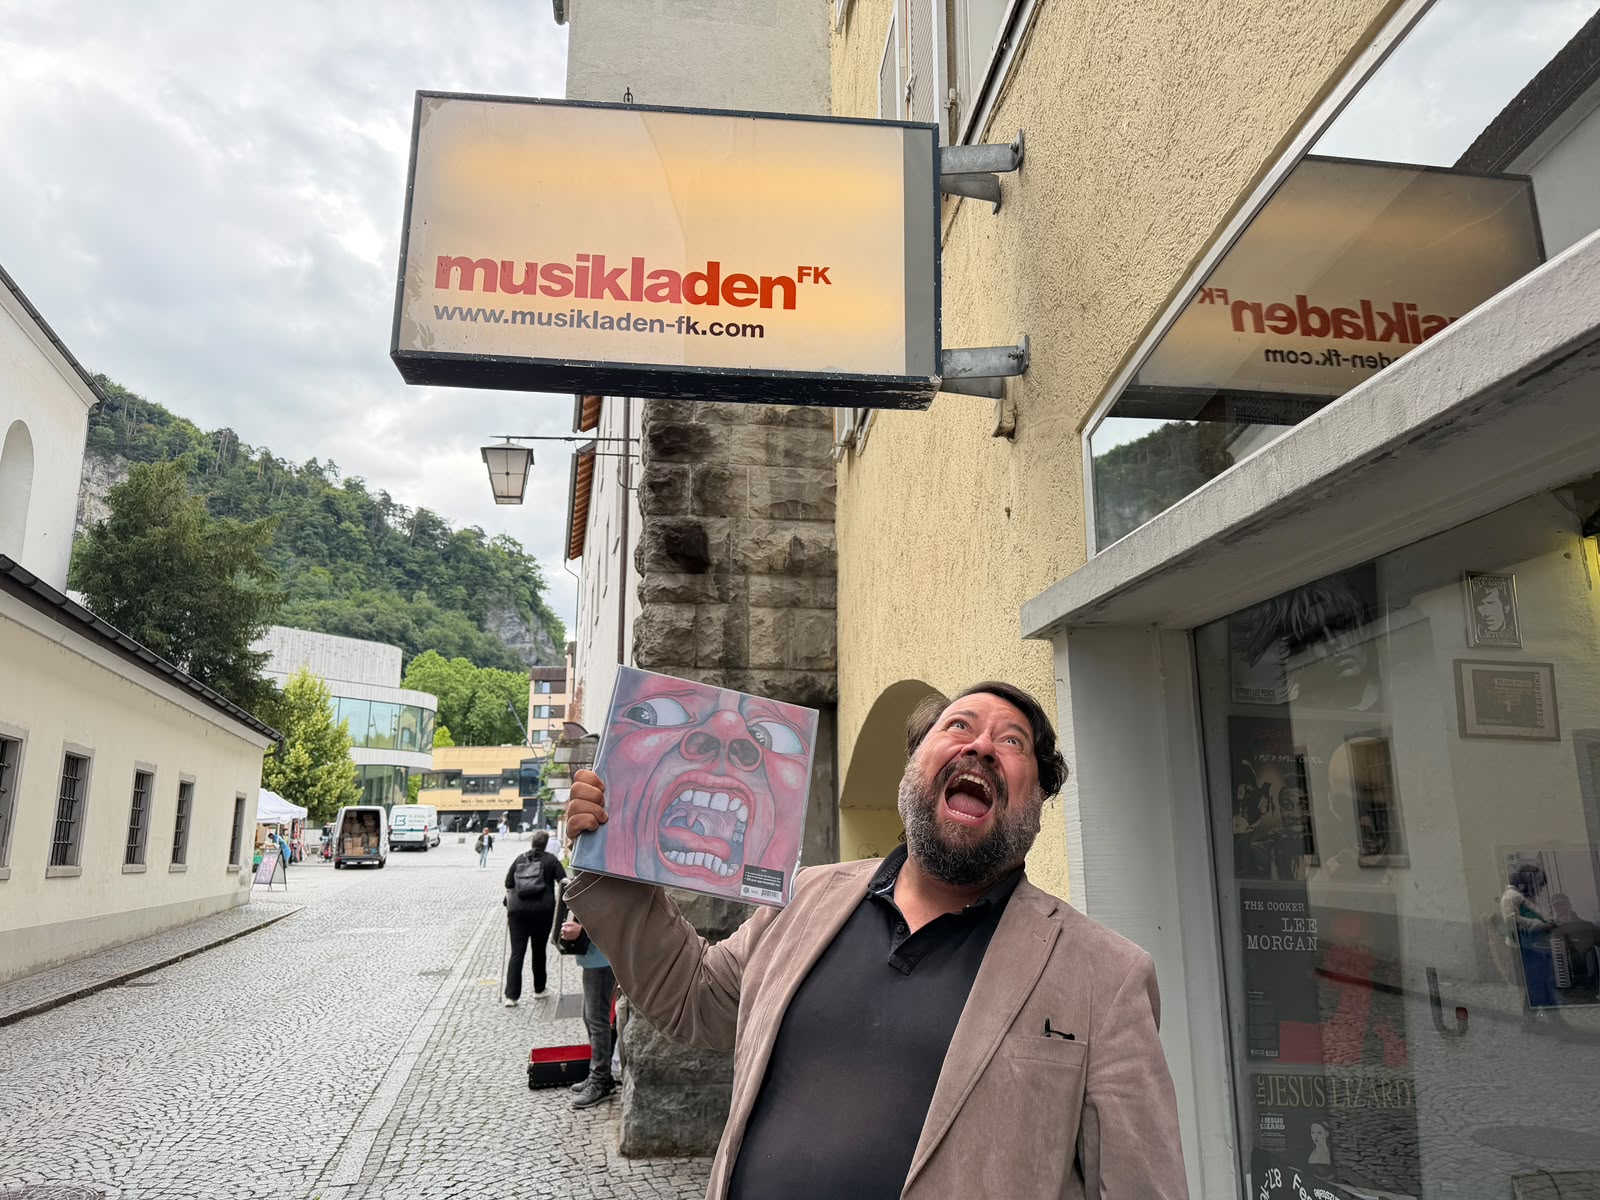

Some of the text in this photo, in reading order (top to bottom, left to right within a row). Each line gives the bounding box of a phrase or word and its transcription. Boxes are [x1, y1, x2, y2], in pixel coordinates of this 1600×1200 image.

[435, 253, 832, 310] musikladen FK
[434, 304, 765, 338] www.musikladen-fk.com
[1243, 900, 1305, 912] THE COOKER
[1281, 917, 1318, 933] LEE
[1246, 934, 1318, 951] MORGAN
[1267, 1075, 1326, 1108] JESUS
[1330, 1076, 1411, 1109] LIZARD
